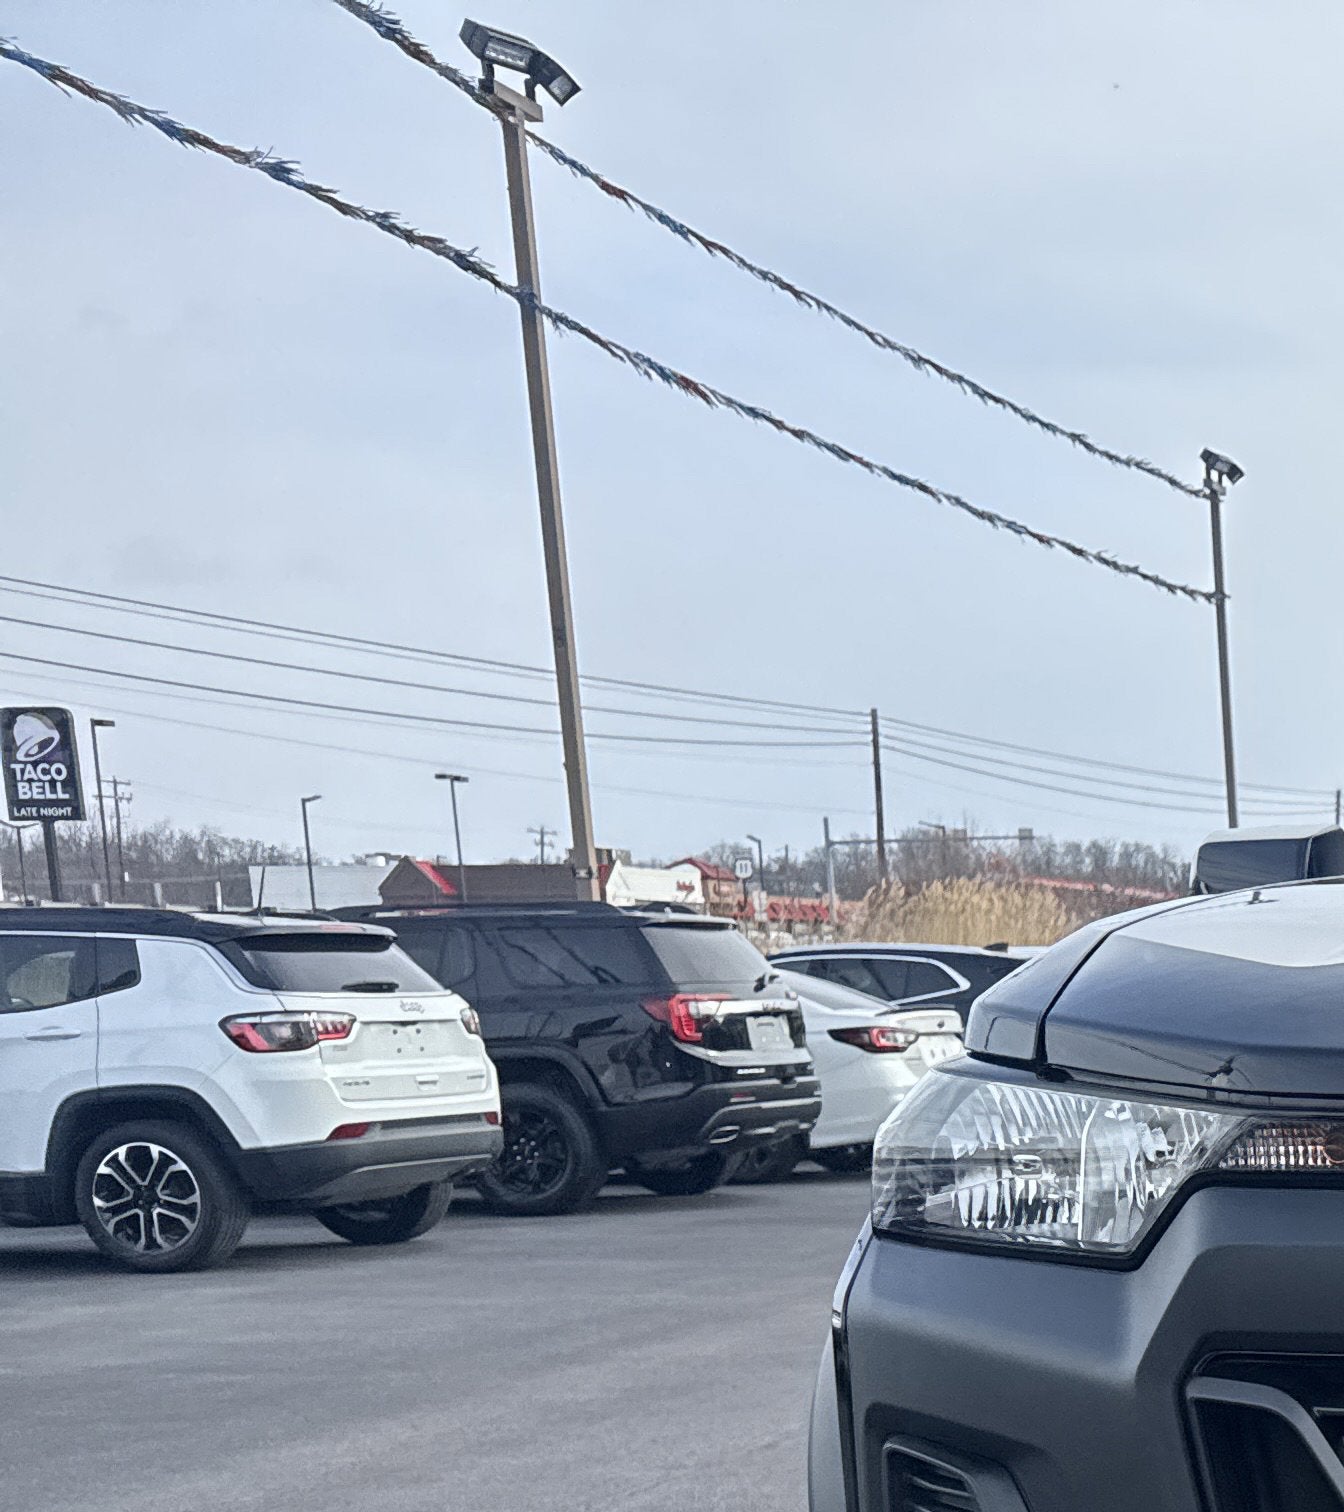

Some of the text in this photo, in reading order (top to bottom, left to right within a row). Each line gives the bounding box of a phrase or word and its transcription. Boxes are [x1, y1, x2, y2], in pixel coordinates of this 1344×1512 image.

[10, 763, 67, 781] TACO
[17, 782, 70, 800] BELL
[13, 806, 73, 817] LATE NIGHT
[739, 862, 748, 874] 11
